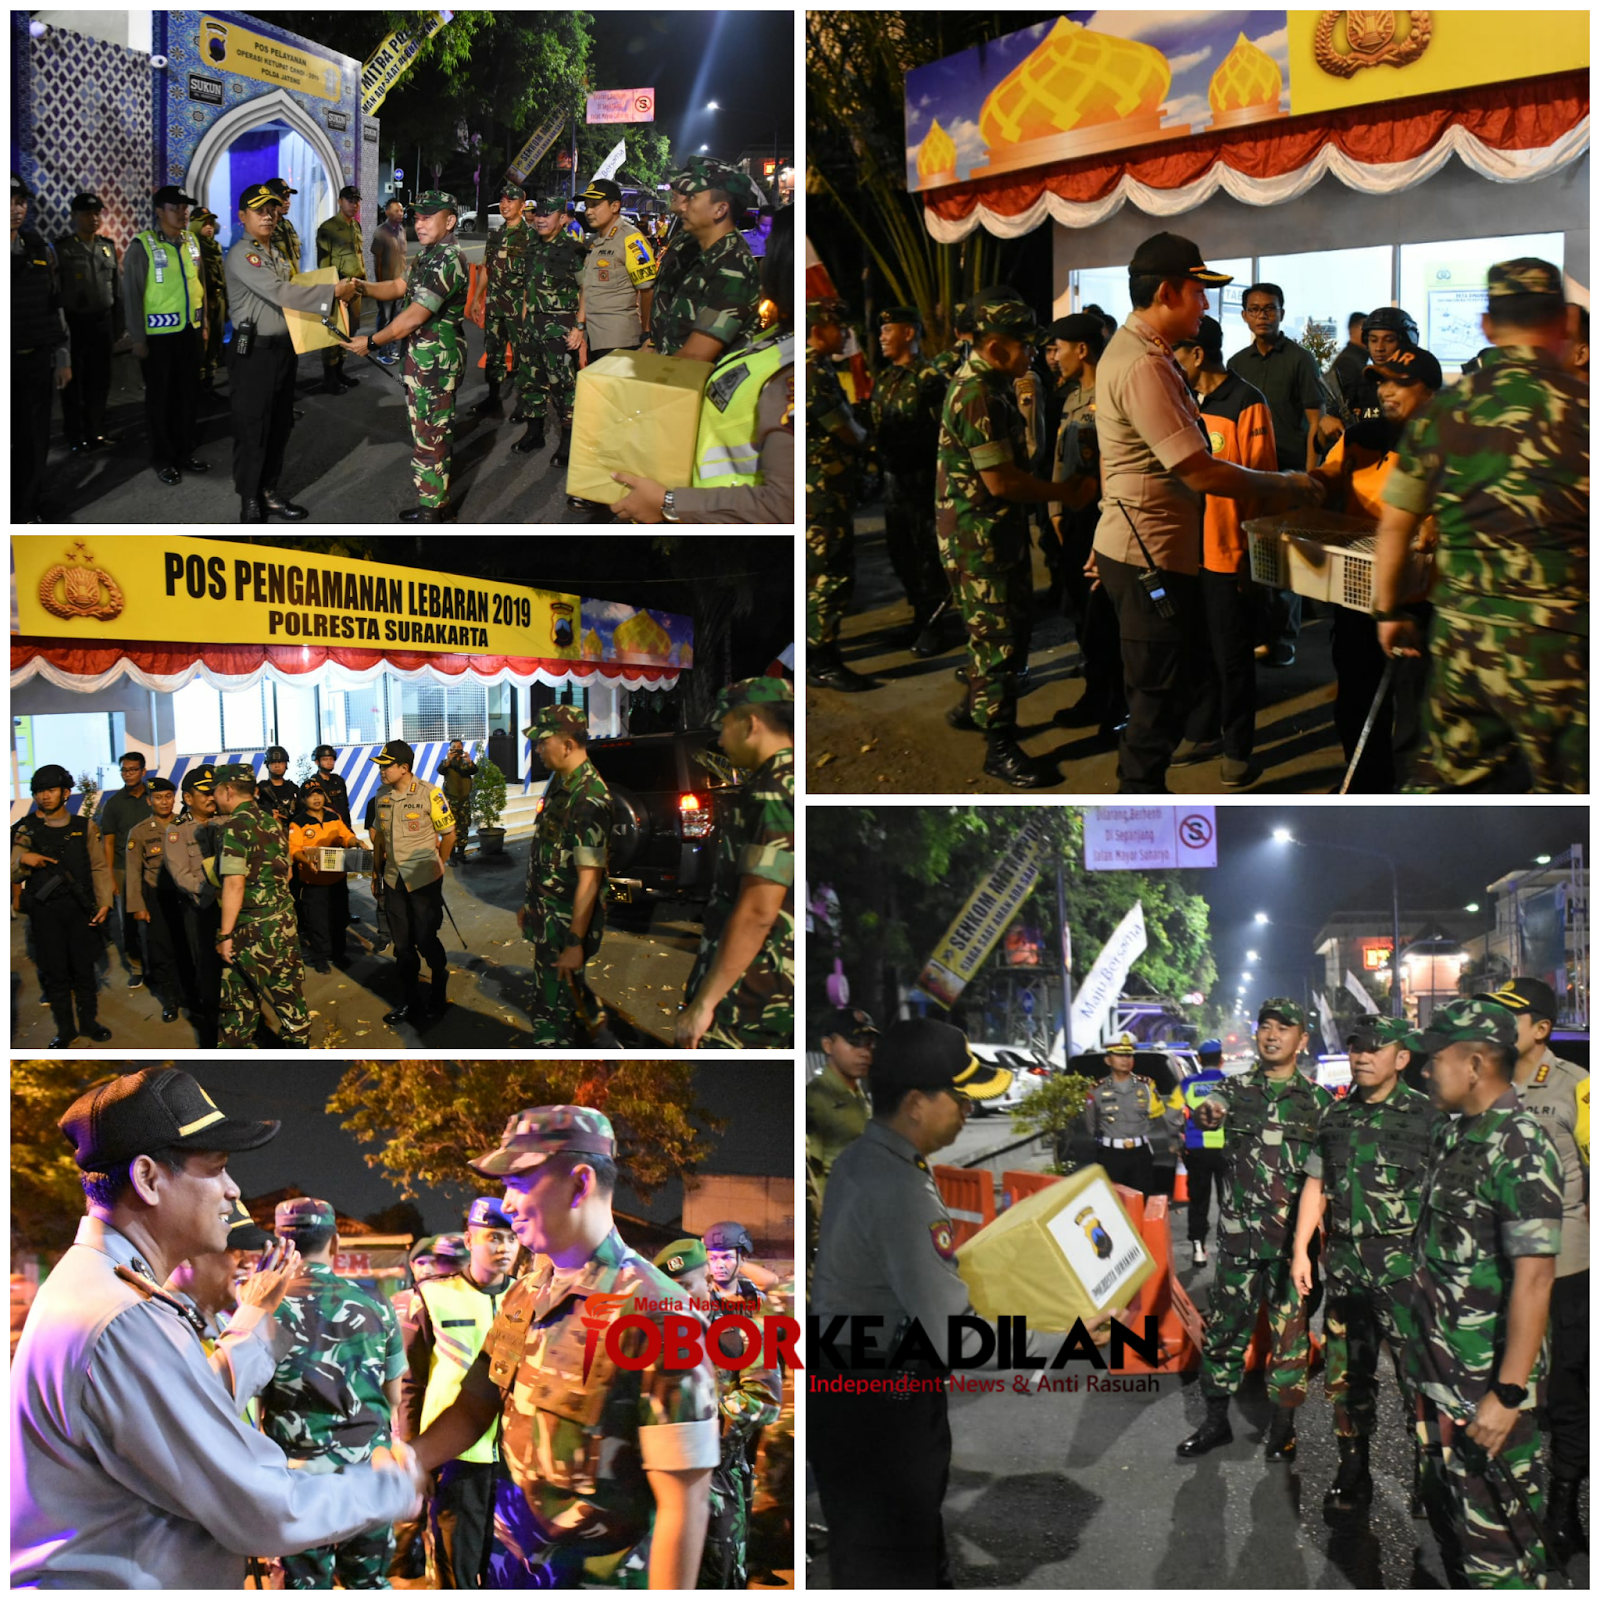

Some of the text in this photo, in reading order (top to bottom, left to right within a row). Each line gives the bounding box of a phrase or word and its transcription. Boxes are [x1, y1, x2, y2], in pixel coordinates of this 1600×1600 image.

[254, 42, 307, 67] POS PELAYANAN
[385, 63, 400, 84] SAAT
[404, 18, 438, 59] BUTKAN
[388, 30, 412, 54] PO
[236, 49, 263, 63] OPERASI
[264, 57, 289, 70] KETUPAT
[190, 78, 222, 96] SUKUN
[261, 68, 301, 86] POLDA JATENG
[520, 134, 544, 162] SENKOM
[601, 148, 625, 178] Bersama
[1081, 412, 1096, 423] POL
[163, 550, 531, 628] POS PENGAMANAN LEBARAN 2019
[268, 610, 489, 648] POLRESTA SURAKARTA
[949, 890, 998, 951] SENKOM
[960, 944, 982, 972] SIAGA
[977, 923, 997, 947] SAAT
[991, 899, 1014, 926] AMAN
[1008, 882, 1026, 903] ADA
[1081, 922, 1143, 1020] Maju Bersama
[1525, 1106, 1556, 1115] OLRI
